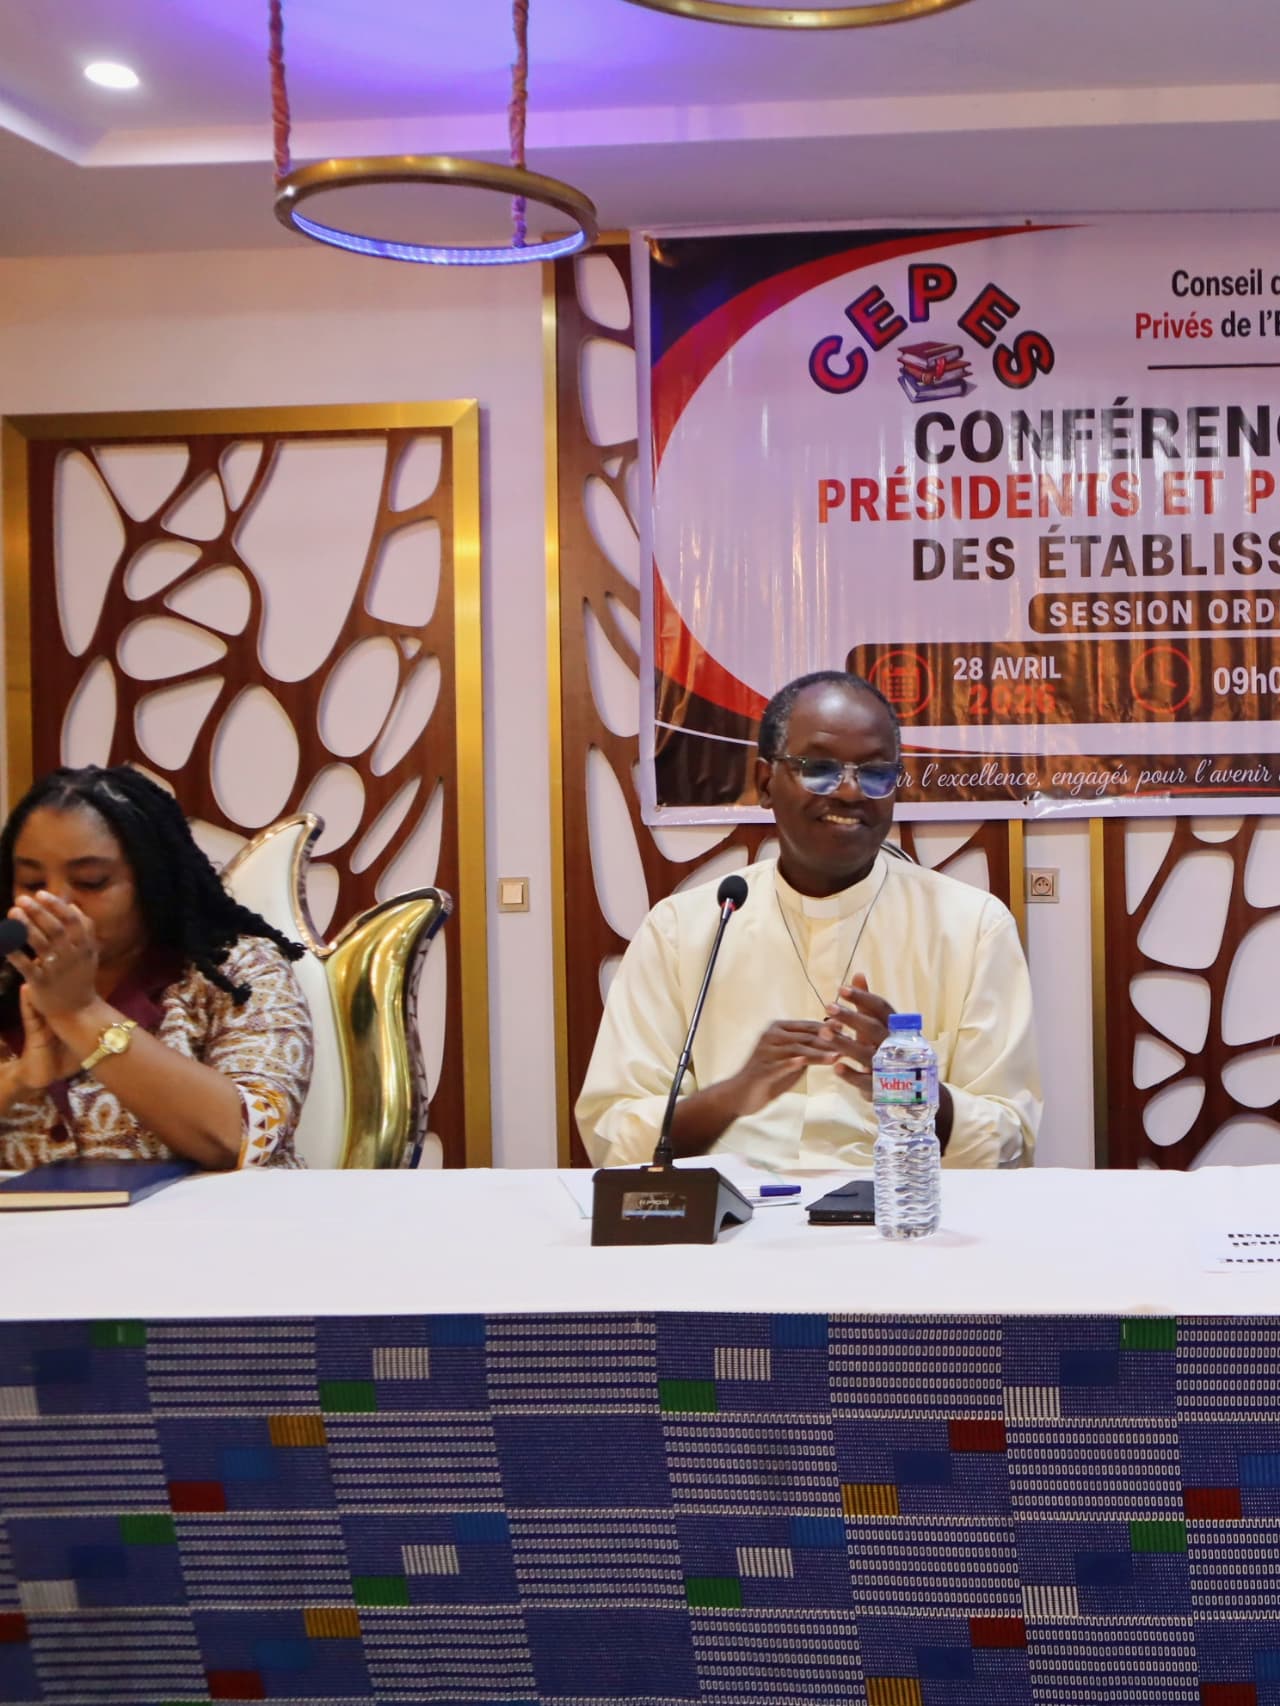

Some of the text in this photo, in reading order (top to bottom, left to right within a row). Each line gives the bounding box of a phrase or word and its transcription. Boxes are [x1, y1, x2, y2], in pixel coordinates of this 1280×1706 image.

[1171, 269, 1262, 297] Conseil
[808, 263, 1055, 394] CEPES
[1135, 310, 1213, 339] Privés
[1220, 310, 1251, 338] de
[818, 466, 1141, 524] PRÉSIDENTS
[1163, 470, 1224, 516] ET
[912, 536, 1015, 581] DES
[1049, 600, 1193, 627] SESSION
[953, 655, 1062, 681] 28 AVRIL
[968, 683, 1056, 715] 2026
[1051, 764, 1129, 795] engagés
[1135, 769, 1187, 796] pour
[1194, 759, 1269, 785] l’avenir
